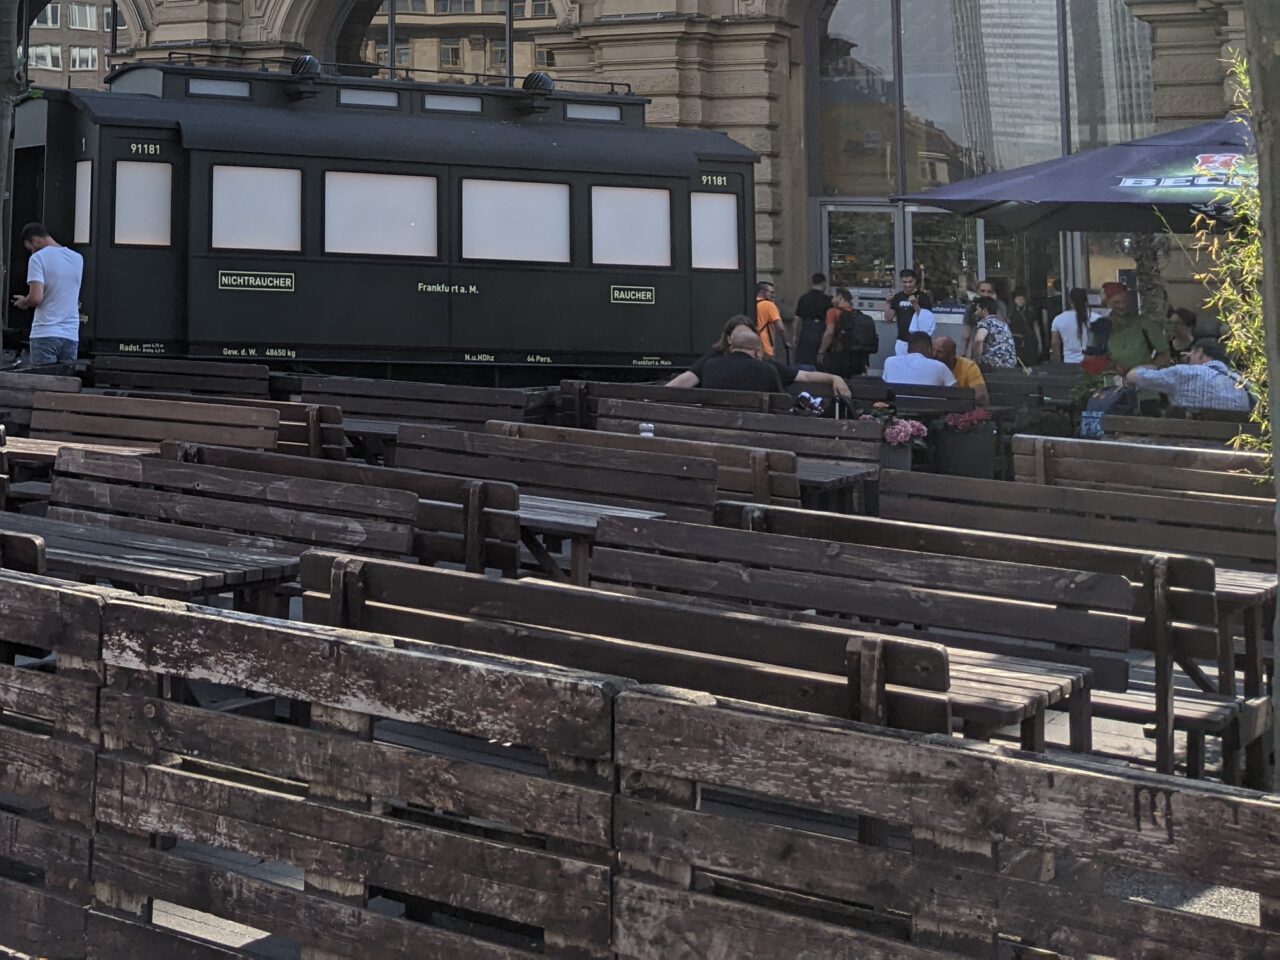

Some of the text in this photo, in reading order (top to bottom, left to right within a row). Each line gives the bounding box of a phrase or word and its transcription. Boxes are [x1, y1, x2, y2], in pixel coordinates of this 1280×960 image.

[130, 143, 161, 155] 91181
[701, 175, 728, 186] 91181
[221, 275, 292, 288] NICHTRAUCHER
[469, 285, 479, 294] M.
[614, 290, 652, 300] RAUCHER
[119, 343, 141, 352] Radst.
[222, 347, 240, 356] Gew.
[249, 348, 258, 356] W.
[265, 348, 287, 357] 48650
[288, 349, 296, 359] kg
[536, 355, 553, 363] Pers.
